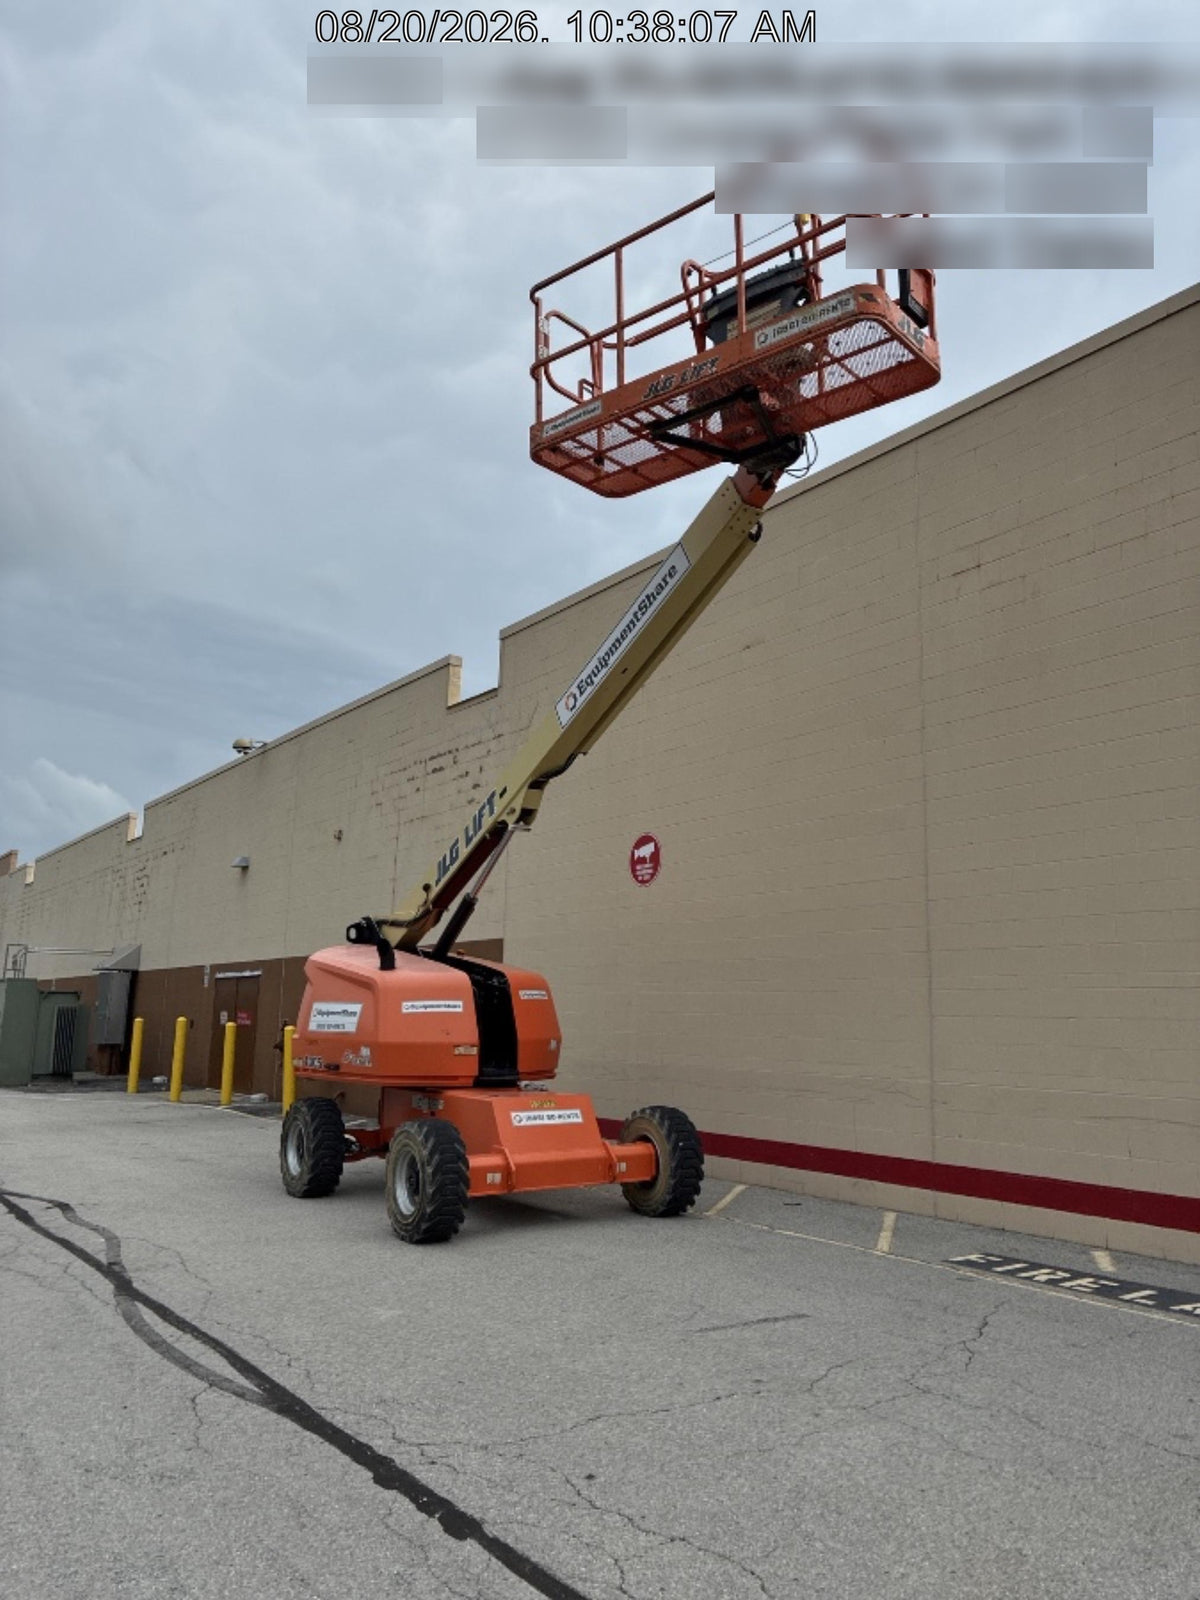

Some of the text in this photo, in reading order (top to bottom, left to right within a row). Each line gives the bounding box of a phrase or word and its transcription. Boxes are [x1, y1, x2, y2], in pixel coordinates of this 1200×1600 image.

[576, 564, 678, 698] EquipmentShare
[435, 788, 497, 887] JLG LIFT
[950, 1254, 1120, 1292] FIRE
